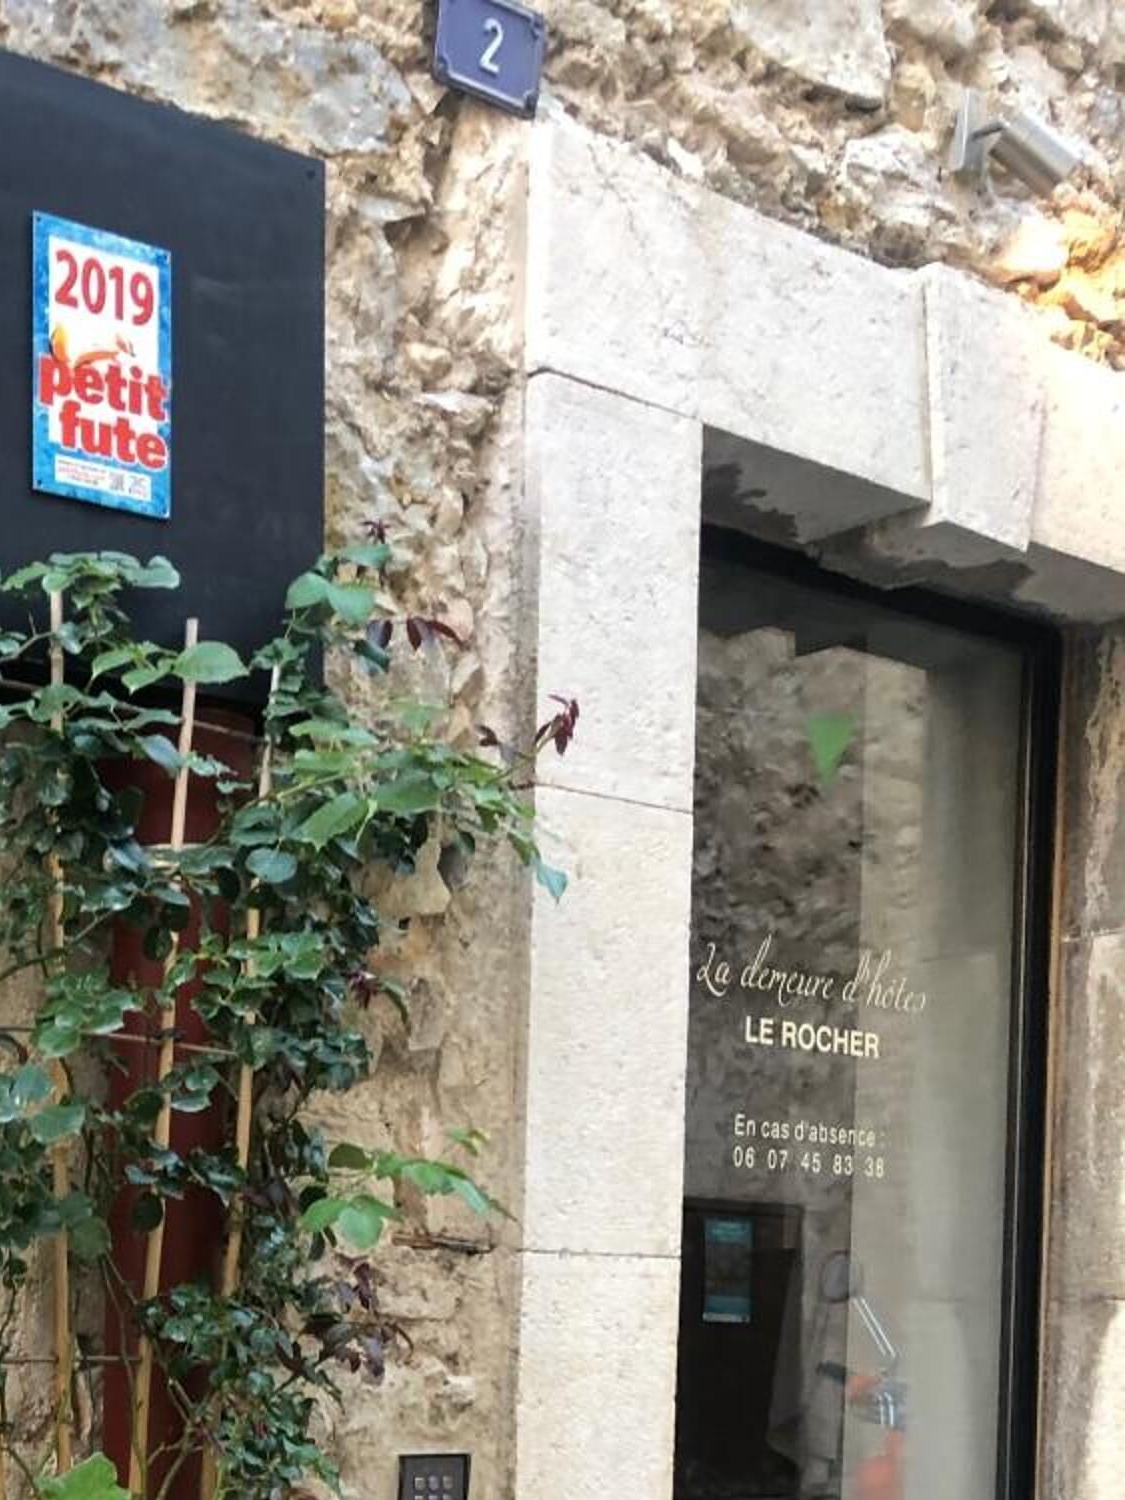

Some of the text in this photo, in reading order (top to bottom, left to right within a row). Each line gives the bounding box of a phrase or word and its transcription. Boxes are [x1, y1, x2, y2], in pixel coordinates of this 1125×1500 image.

[480, 18, 503, 73] 2
[54, 249, 154, 326] 2019
[38, 353, 167, 421] petit
[697, 942, 731, 997] La
[740, 933, 834, 1007] demeure
[745, 1015, 881, 1059] LE ROCHER
[734, 1113, 756, 1137] En
[760, 1120, 790, 1140] cas
[794, 1120, 876, 1148] d'absence
[733, 1145, 884, 1178] 06 07 45 83 38
